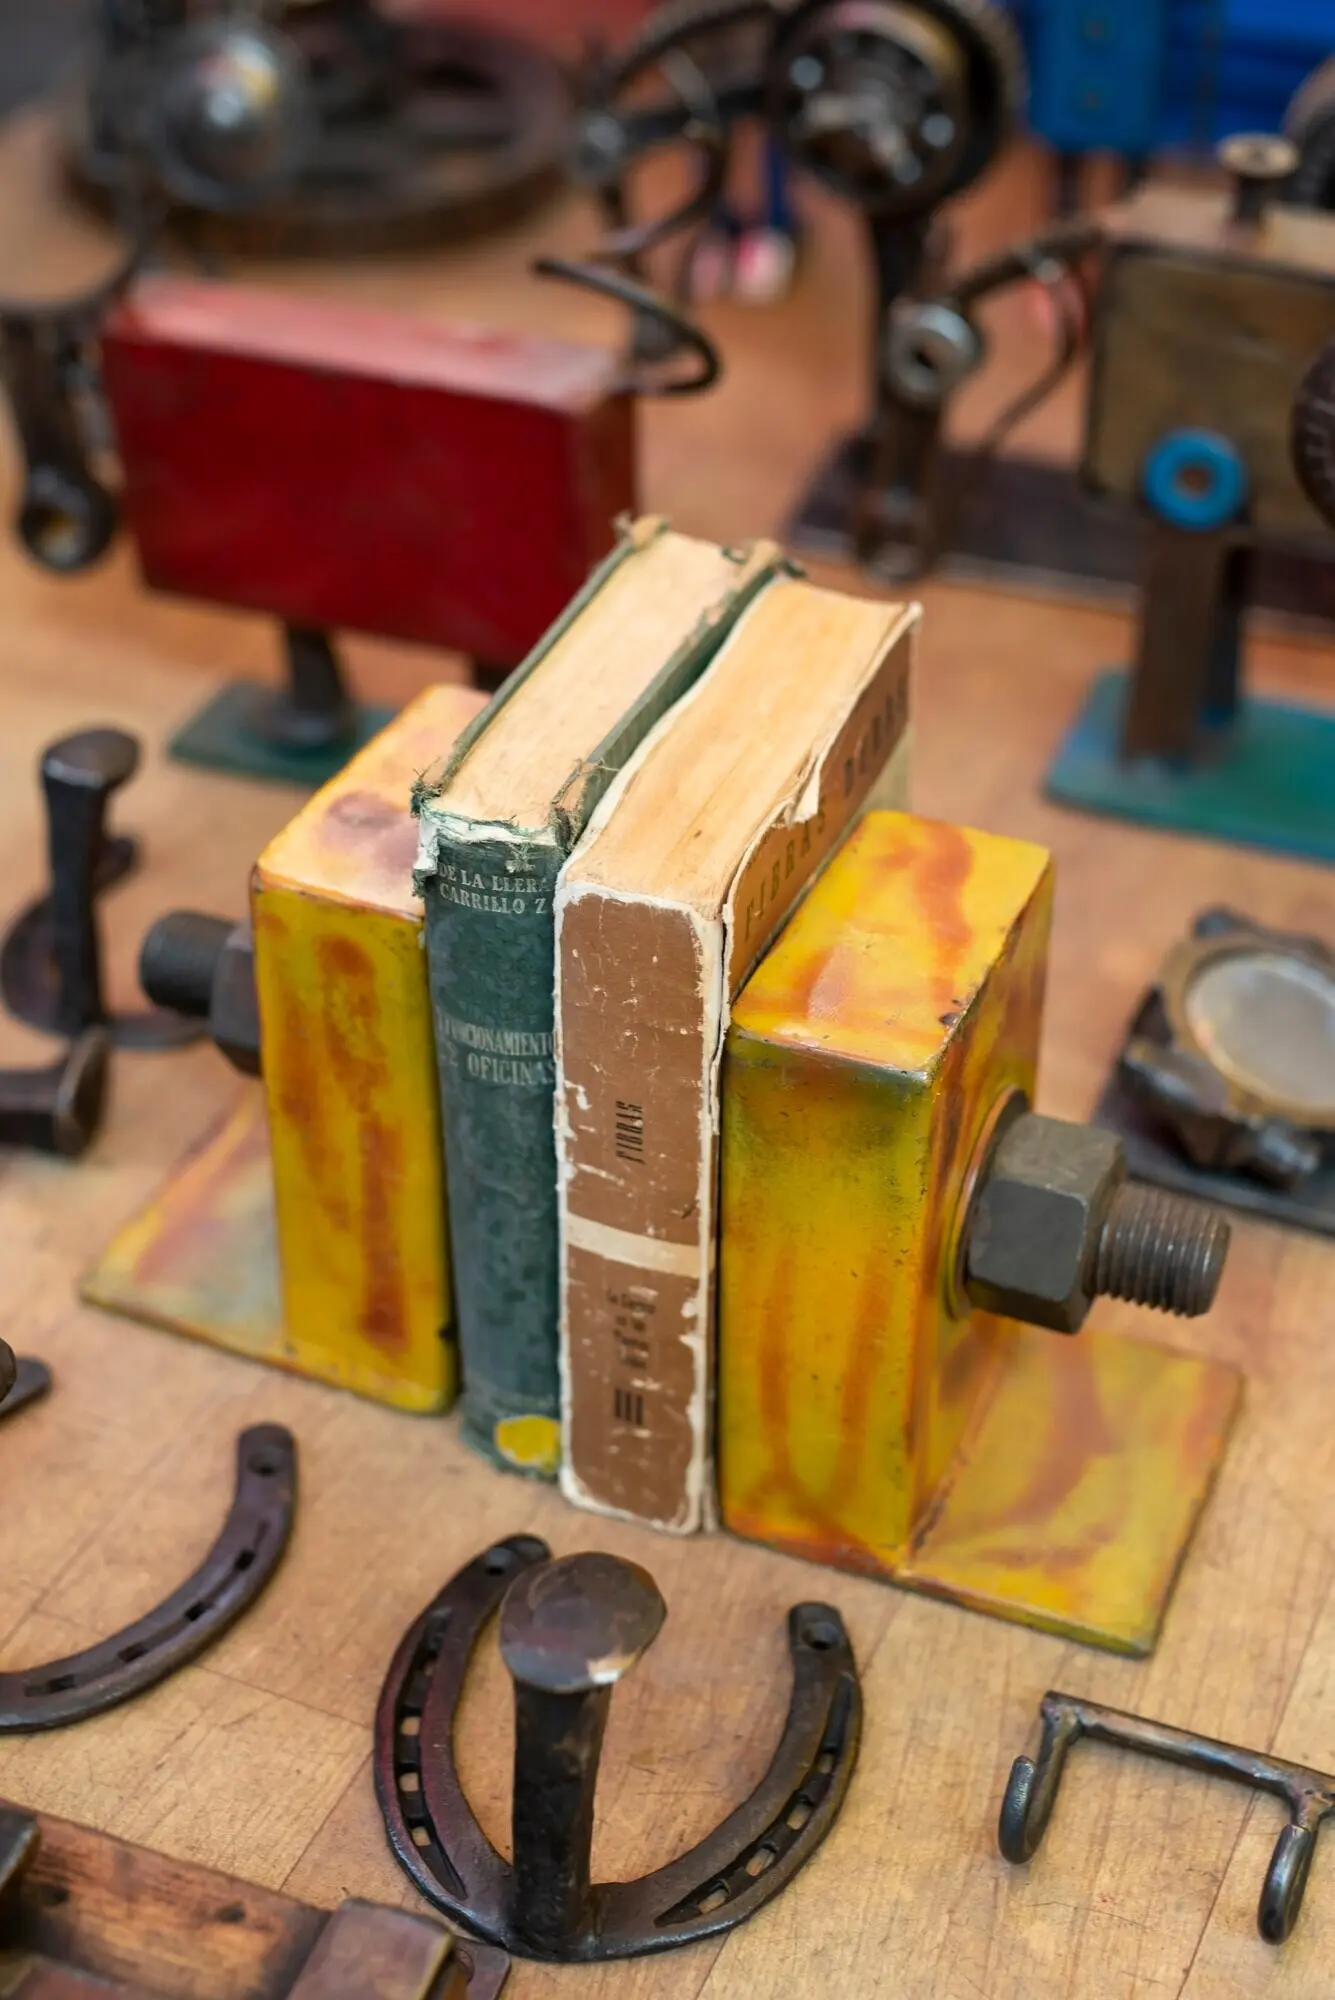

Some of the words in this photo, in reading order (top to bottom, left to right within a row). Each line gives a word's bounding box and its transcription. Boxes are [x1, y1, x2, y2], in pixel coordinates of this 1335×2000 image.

[440, 863, 457, 881] DE
[461, 870, 485, 889] LA
[492, 876, 552, 893] LLERA
[440, 883, 525, 914] CARRILLO
[535, 898, 547, 914] Z
